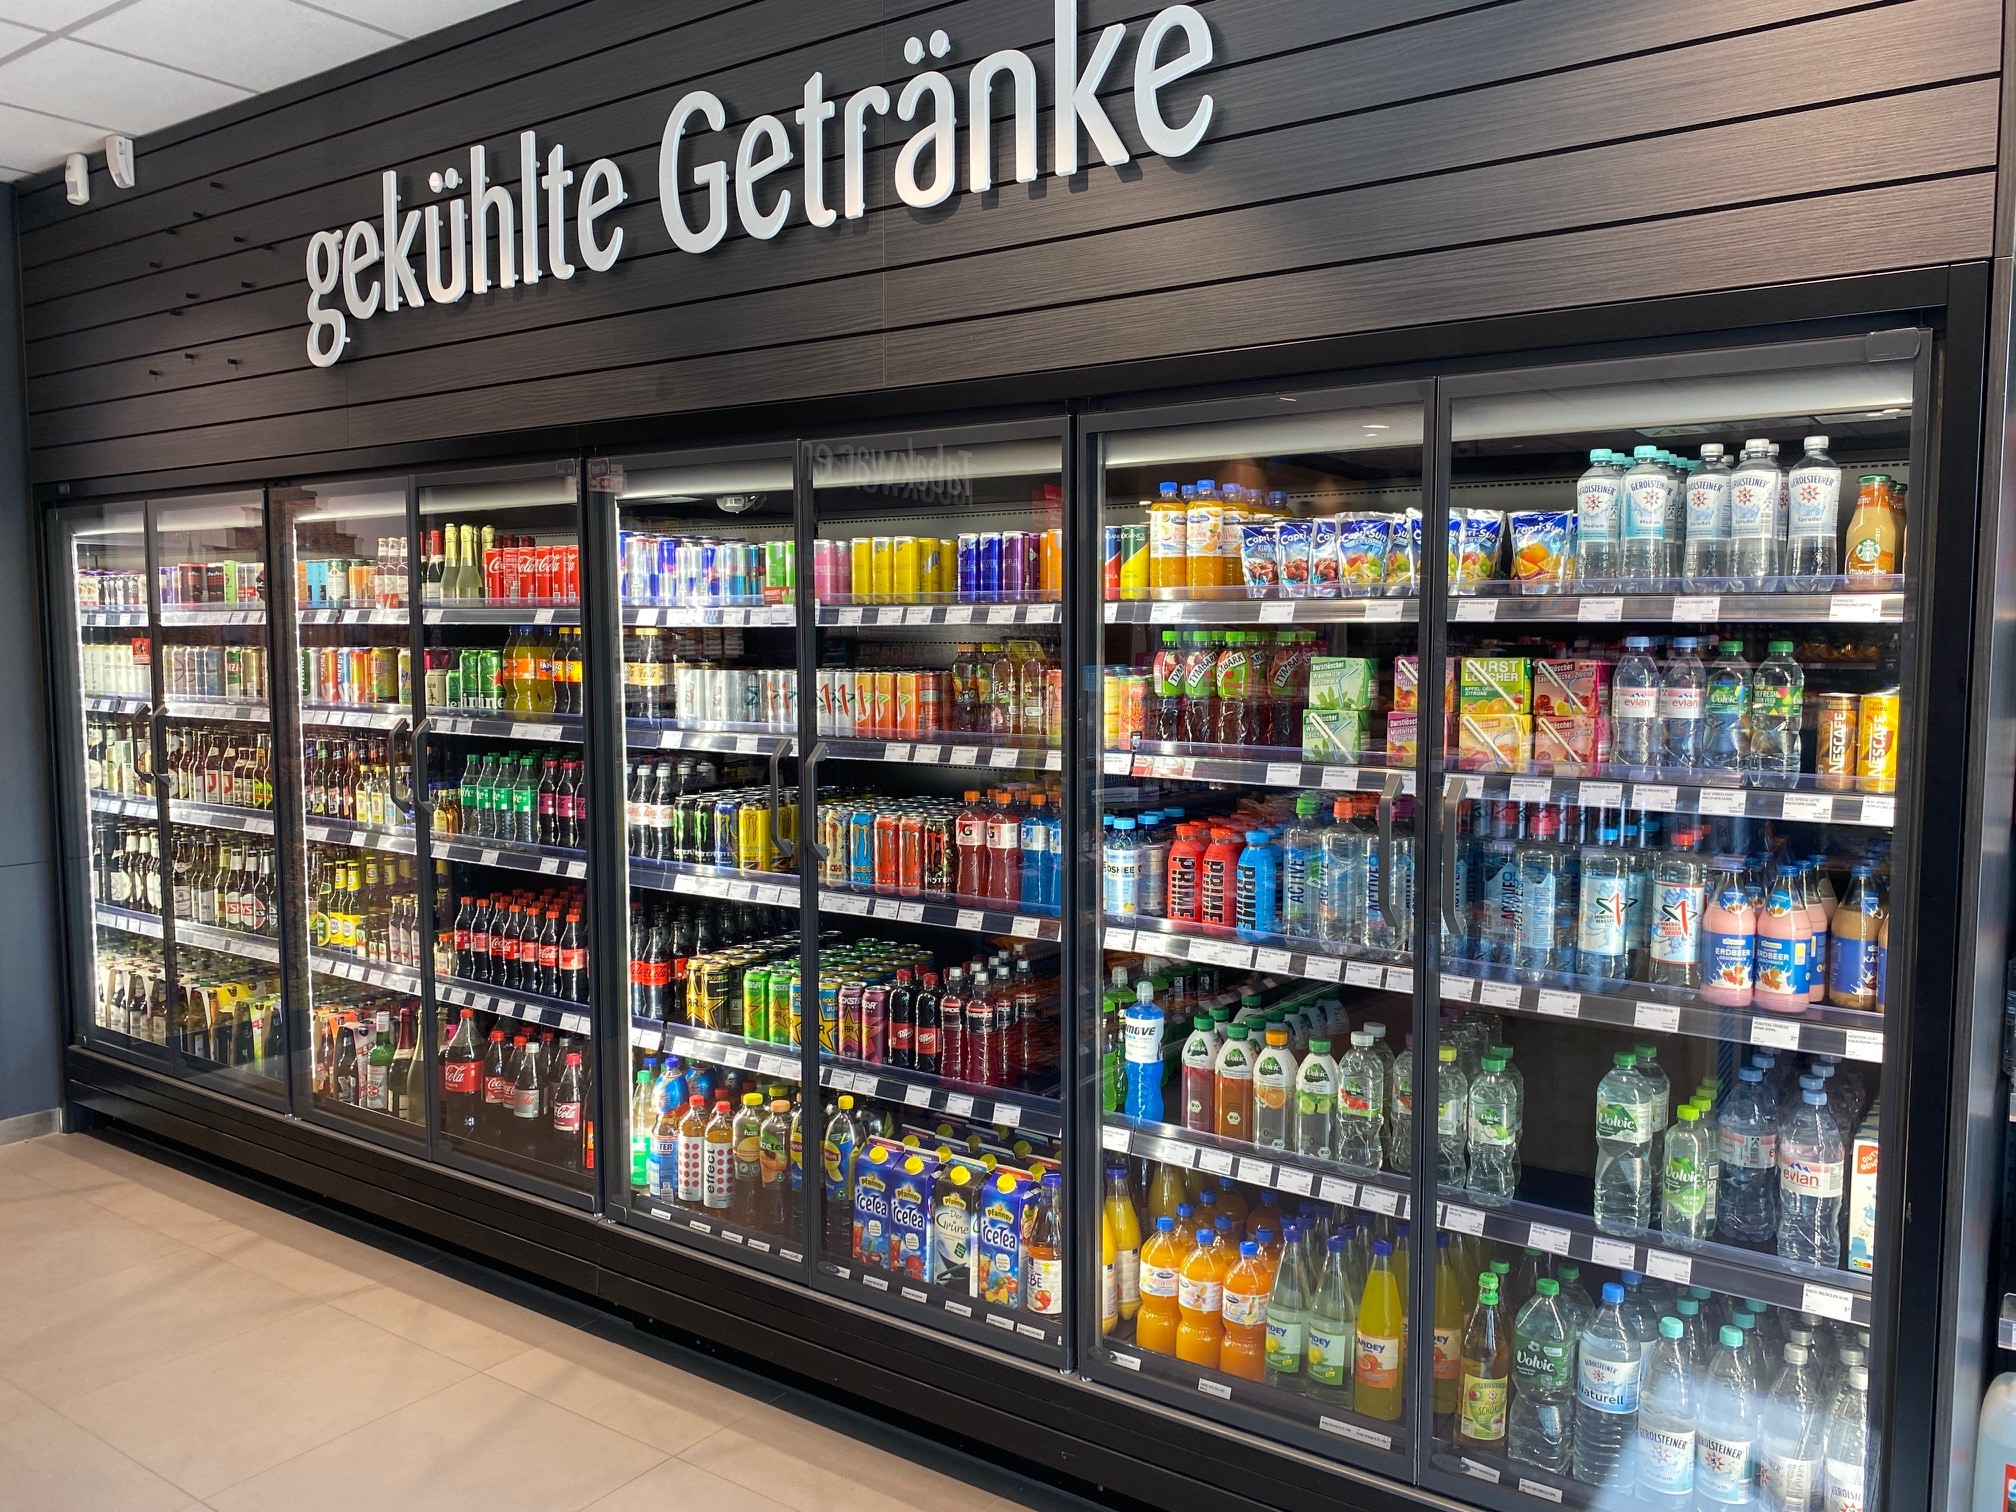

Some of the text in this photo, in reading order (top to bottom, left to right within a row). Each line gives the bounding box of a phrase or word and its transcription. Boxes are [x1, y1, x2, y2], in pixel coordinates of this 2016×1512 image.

[306, 0, 1215, 367] gekühlte Getränke
[1631, 480, 1667, 491] GEROLSTEIN
[1790, 474, 1835, 489] GEROLSTEINER
[1341, 529, 1387, 543] Capri-Sun
[1515, 522, 1565, 537] Capri-Sun
[1246, 533, 1277, 546] Capri-S
[1280, 531, 1311, 544] Capri-
[1217, 653, 1245, 684] YMBARK
[1312, 661, 1345, 672] Durstlöscher
[1624, 699, 1651, 708] evian
[1672, 699, 1698, 708] evian
[1711, 694, 1738, 704] Volvic
[962, 823, 973, 836] G
[987, 825, 996, 838] G
[1170, 856, 1196, 920] PRIME
[1202, 860, 1225, 924] PRIME
[1236, 864, 1257, 931] PRIME
[1715, 947, 1751, 957] ERDBEER
[1757, 949, 1790, 961] ERDBEER
[1599, 1112, 1637, 1131] Volvic
[707, 1149, 715, 1194] effect
[1665, 1164, 1703, 1183] Volvic
[1783, 1168, 1820, 1187] evian
[949, 1209, 963, 1220] Der
[936, 1212, 970, 1236] Grüne
[1516, 1350, 1555, 1372] Volvic
[1584, 1358, 1618, 1375] GEROLSTEINER
[1579, 1383, 1624, 1405] Naturell
[1639, 1427, 1688, 1450] GEROLSTEINER
